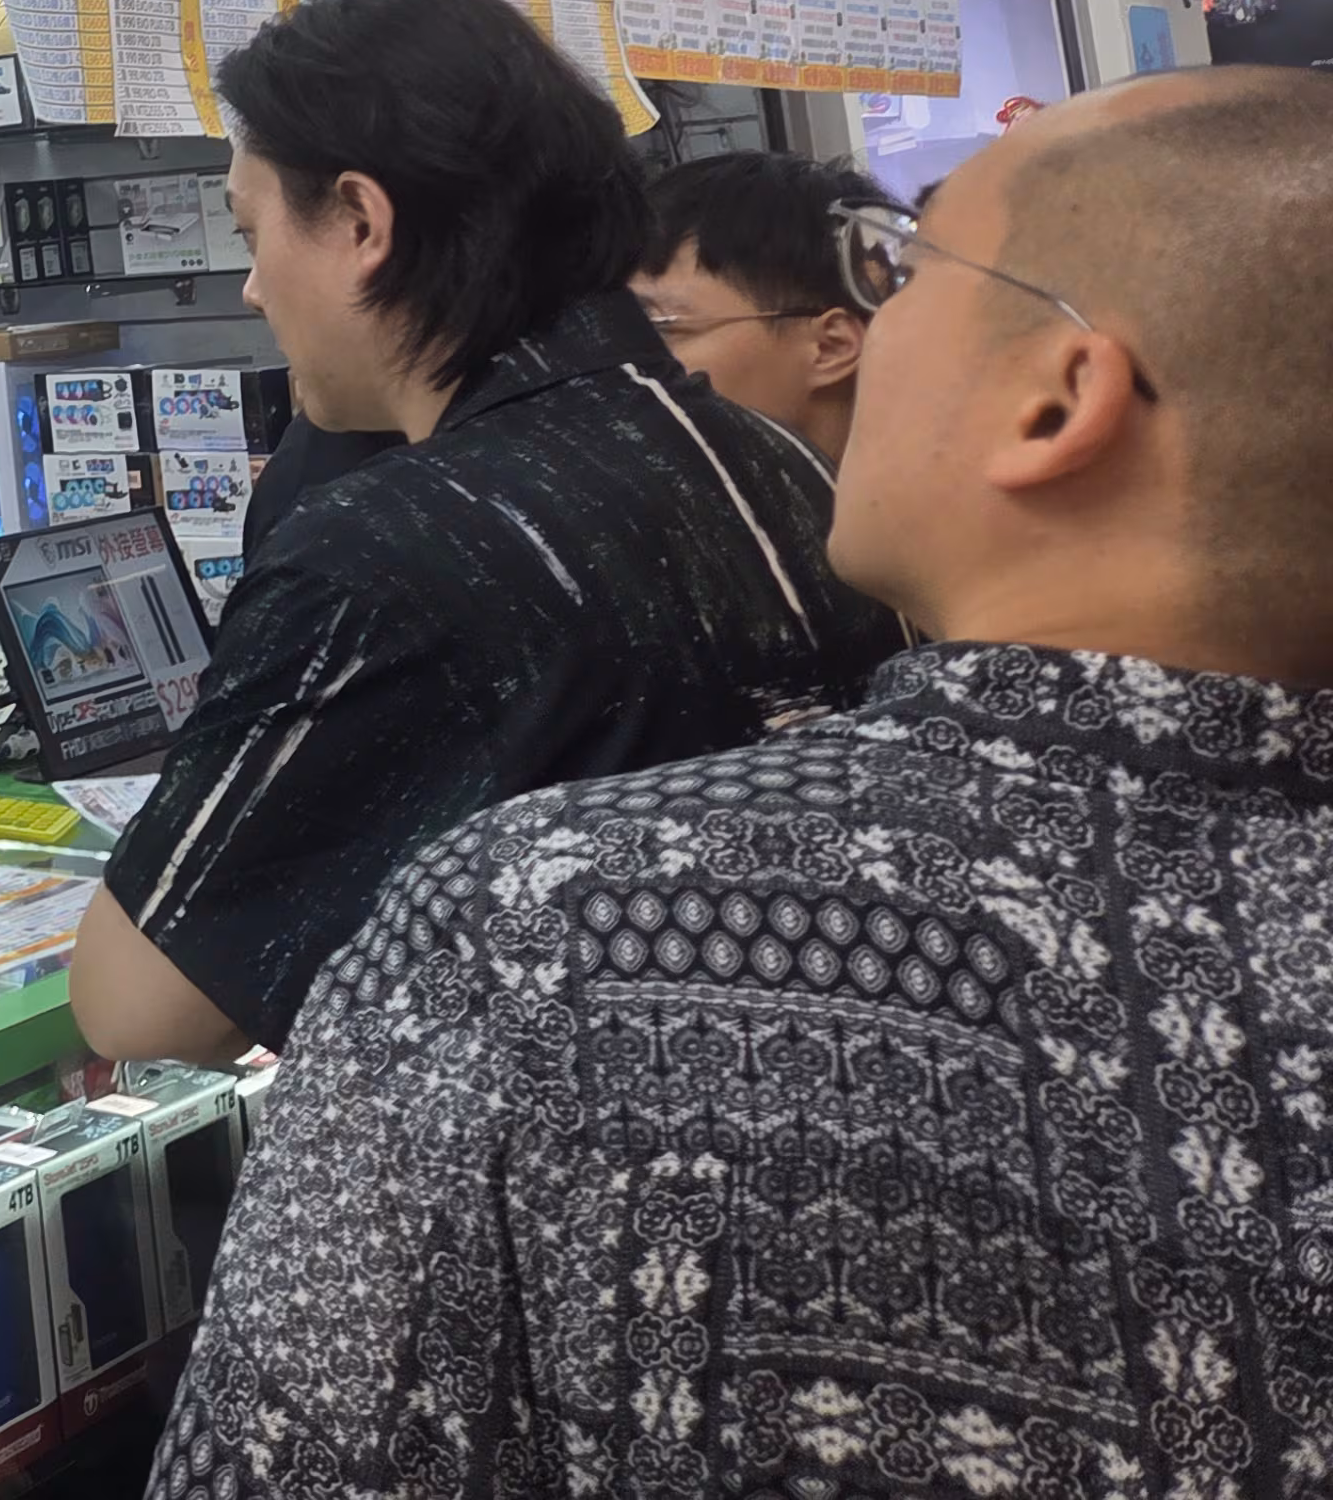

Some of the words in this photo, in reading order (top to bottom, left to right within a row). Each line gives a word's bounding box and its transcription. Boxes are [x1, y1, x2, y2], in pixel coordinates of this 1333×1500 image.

[215, 1091, 236, 1115] 1TB
[116, 1136, 139, 1163] 1TB
[9, 1184, 34, 1211] 4TB
